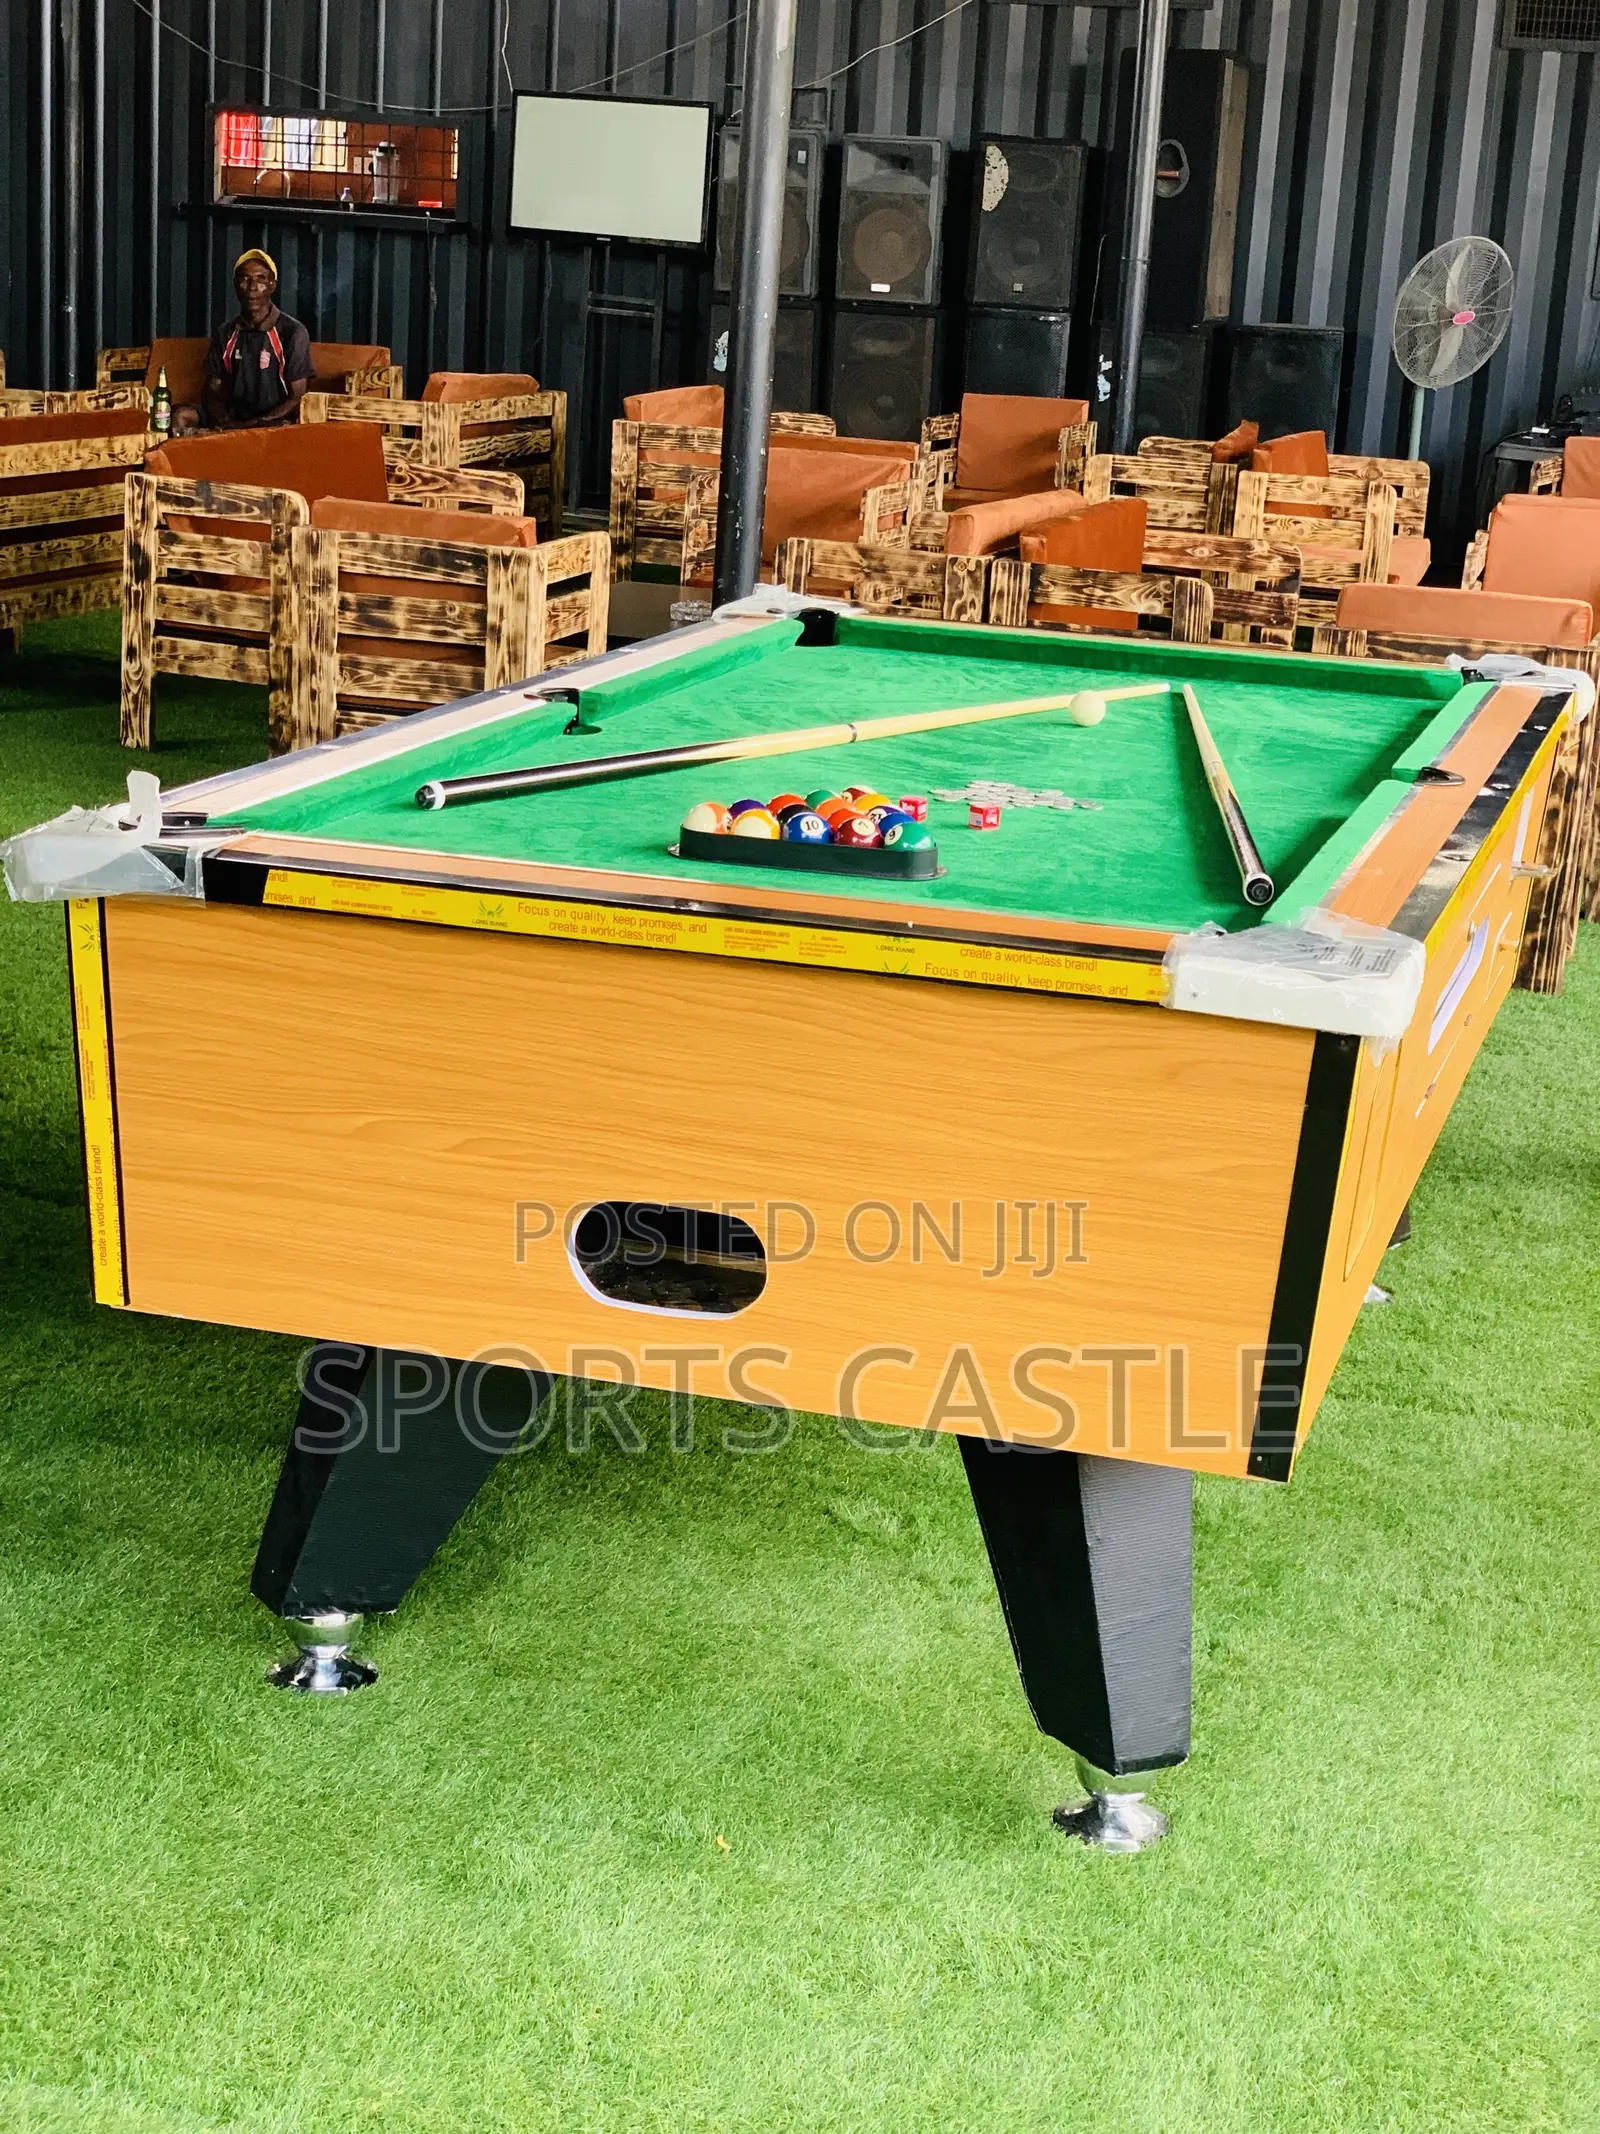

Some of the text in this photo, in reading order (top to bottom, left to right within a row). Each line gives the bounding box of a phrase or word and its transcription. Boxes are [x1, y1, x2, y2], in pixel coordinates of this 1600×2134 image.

[805, 821, 819, 831] 10
[858, 821, 869, 830] 7
[299, 895, 316, 906] and
[517, 902, 708, 933] Focus on quality, keep promises, and
[549, 921, 677, 944] create a world-class brand!
[960, 947, 1098, 971] create a world-class brand!
[925, 962, 959, 977] Focus
[963, 968, 977, 979] on
[981, 972, 1022, 987] quality,
[1027, 975, 1053, 990] keep
[1056, 980, 1105, 995] promises,
[1108, 985, 1129, 997] and
[91, 1144, 102, 1174] brand!
[94, 1177, 105, 1227] world-class
[98, 1238, 108, 1266] create
